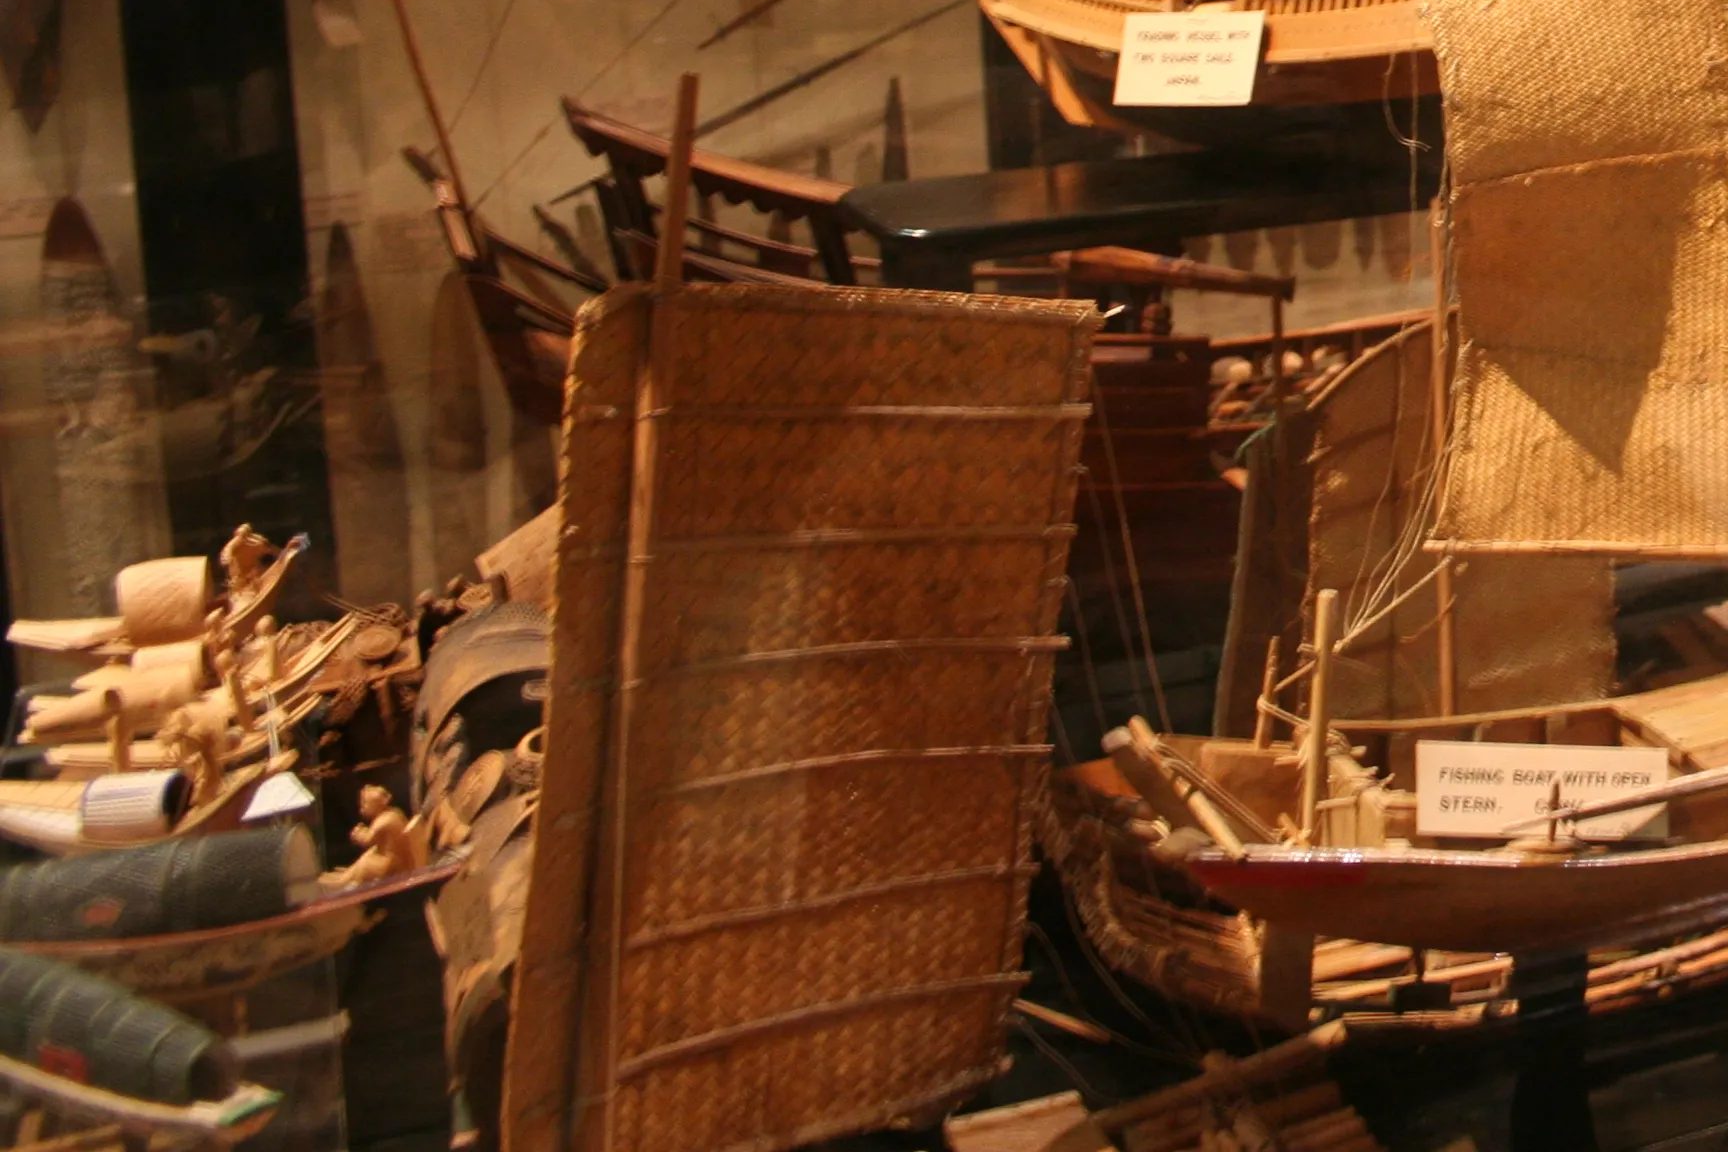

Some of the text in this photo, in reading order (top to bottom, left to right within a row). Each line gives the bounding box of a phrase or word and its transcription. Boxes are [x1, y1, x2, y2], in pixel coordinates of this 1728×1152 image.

[1439, 766, 1652, 789] FISHING BOAT WITH OPEN
